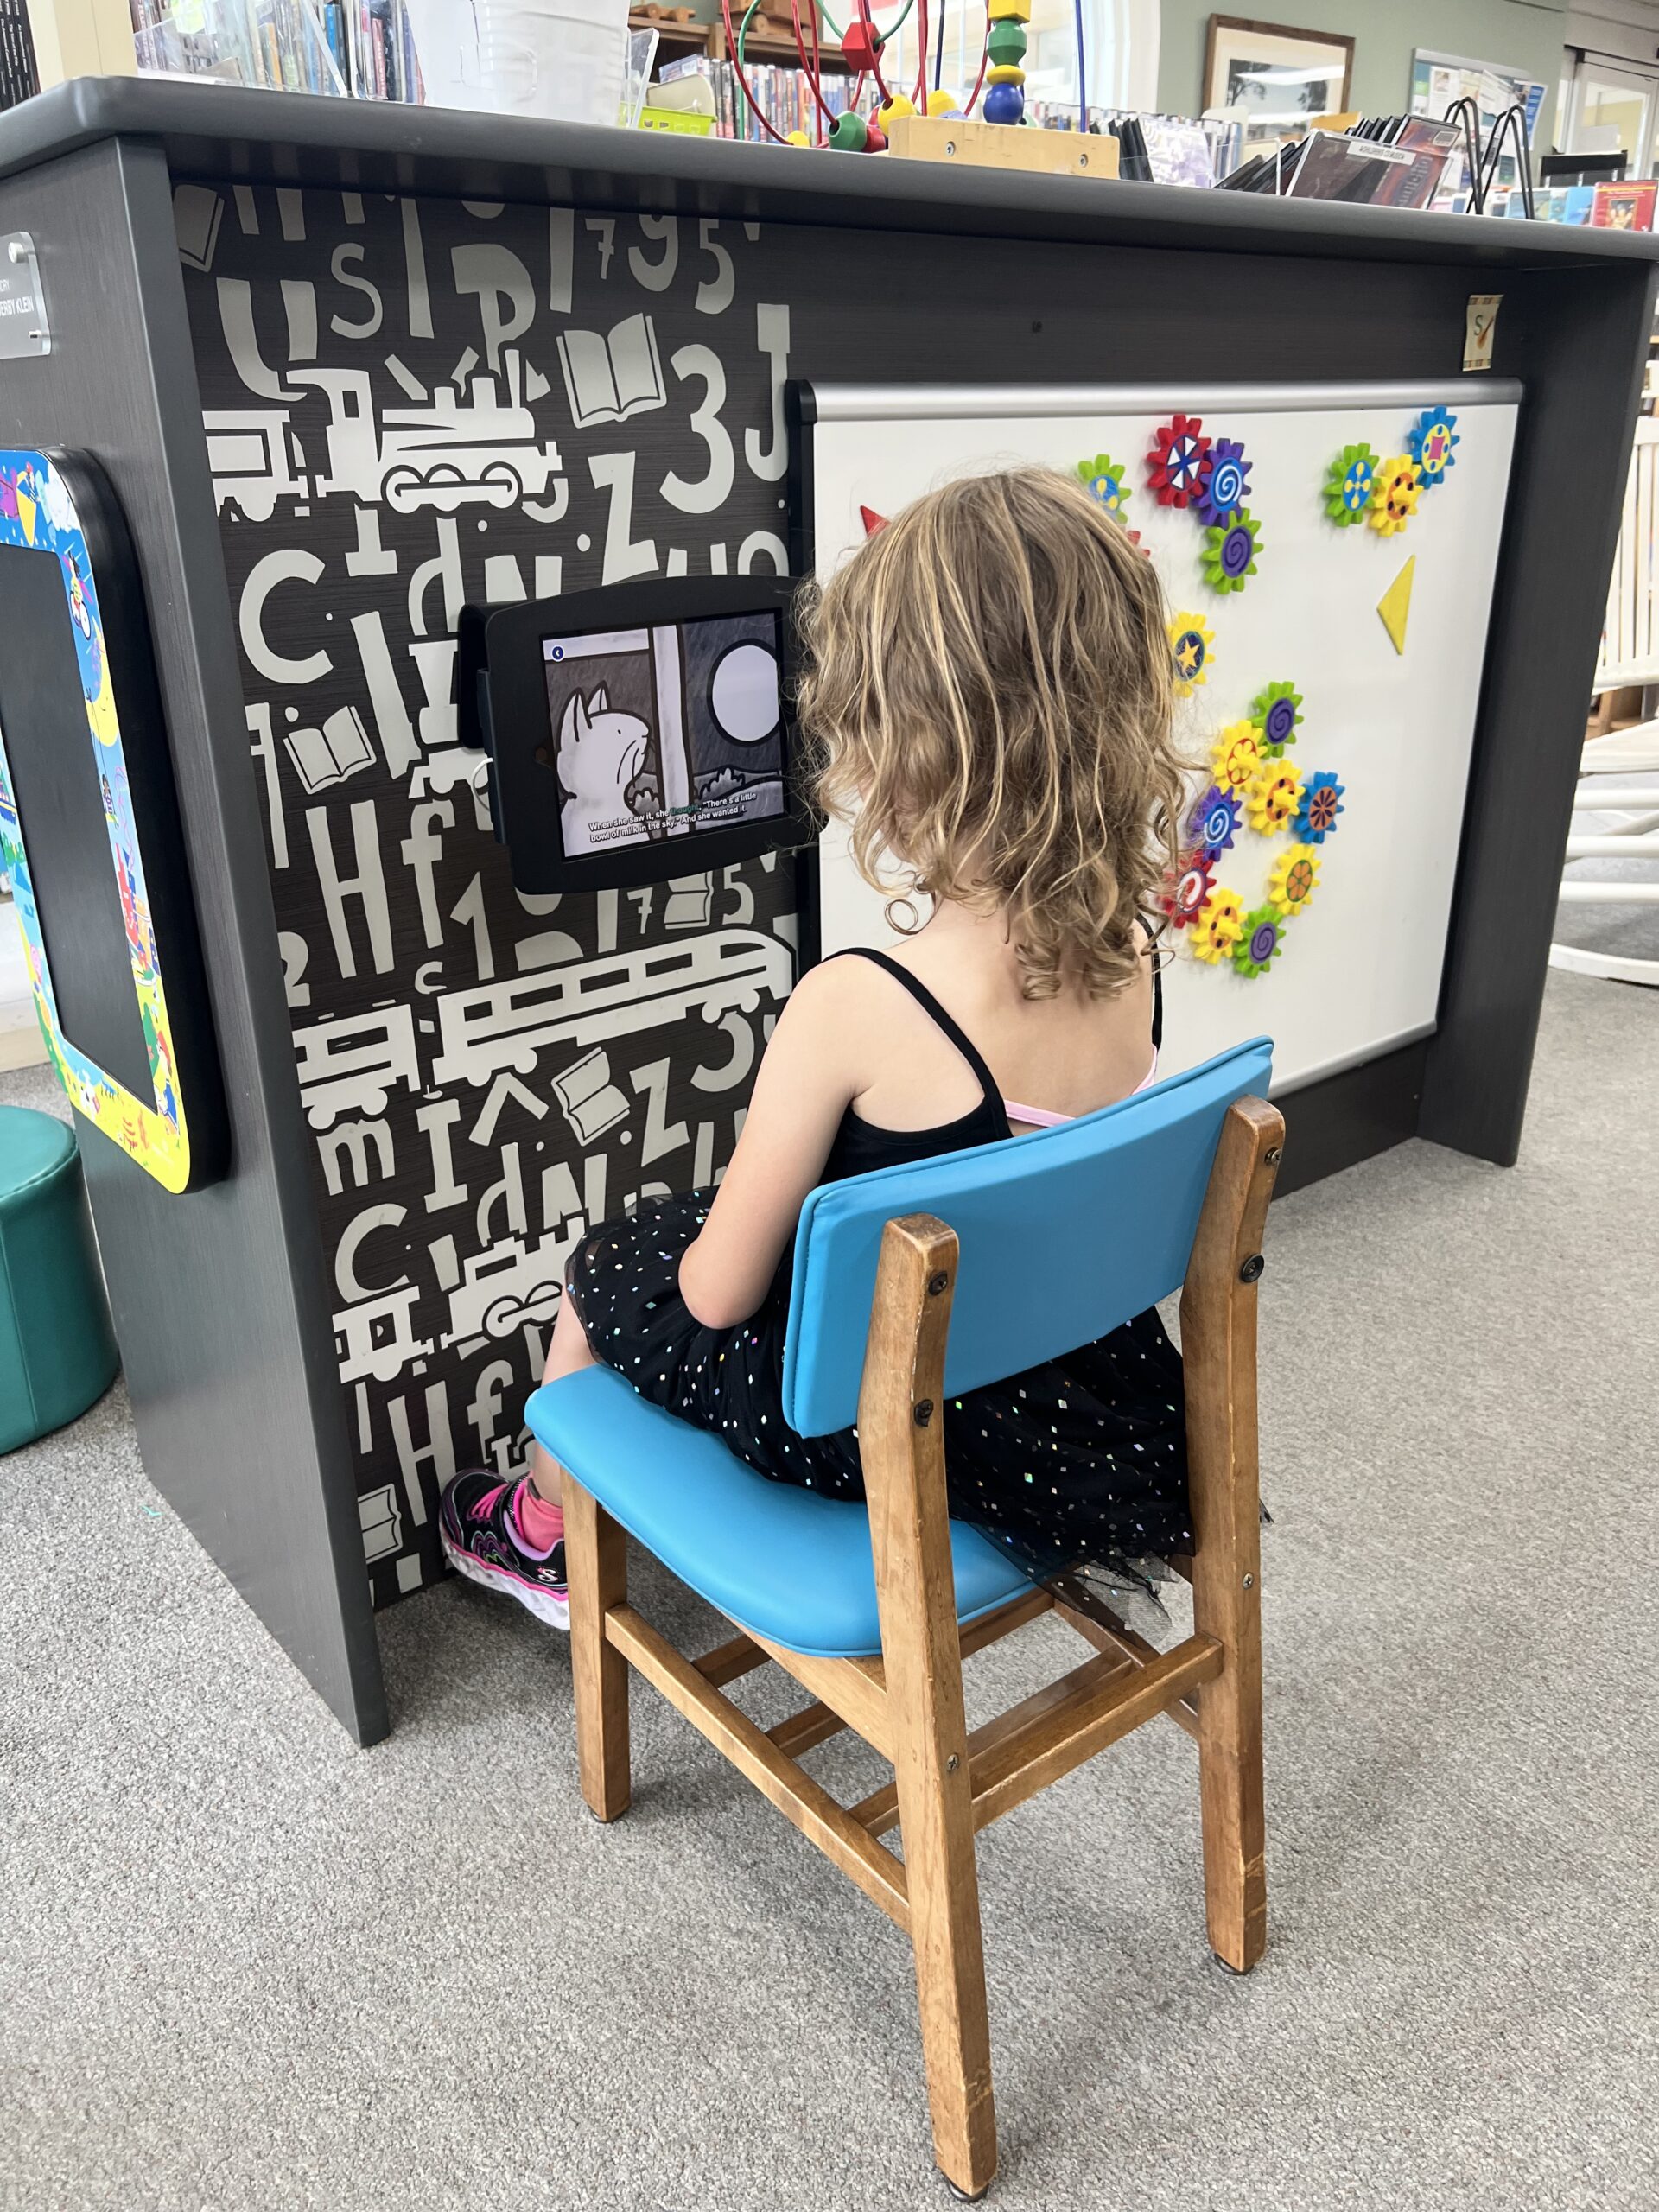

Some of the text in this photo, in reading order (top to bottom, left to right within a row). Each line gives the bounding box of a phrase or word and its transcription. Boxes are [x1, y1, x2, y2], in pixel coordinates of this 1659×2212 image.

[330, 243, 383, 339] S
[585, 219, 616, 279] 7
[695, 219, 735, 314] 5
[0, 296, 34, 316] ERBY KLEIN
[659, 344, 734, 513] 3
[745, 303, 791, 481] J
[588, 451, 659, 586] Z
[238, 549, 334, 684] C
[589, 817, 613, 831] When
[613, 816, 629, 827] she
[629, 814, 645, 825] saw
[645, 810, 655, 823] it,
[655, 810, 669, 818] she
[670, 804, 702, 816] thought,
[702, 795, 734, 810] "There's
[741, 792, 758, 802] little
[589, 830, 611, 843] bowl
[611, 828, 620, 839] of
[620, 824, 639, 837] milk
[639, 822, 647, 833] in
[647, 819, 661, 831] the
[661, 817, 681, 830] sky."
[681, 815, 696, 824] And
[697, 810, 711, 822] she
[712, 807, 739, 819] wanted
[306, 799, 394, 979] H
[401, 799, 455, 948] f
[627, 887, 653, 935] 7
[416, 1098, 468, 1213] I
[630, 1057, 690, 1167] Z
[477, 1142, 529, 1248] d
[541, 1154, 608, 1230] N
[387, 1380, 457, 1527] H
